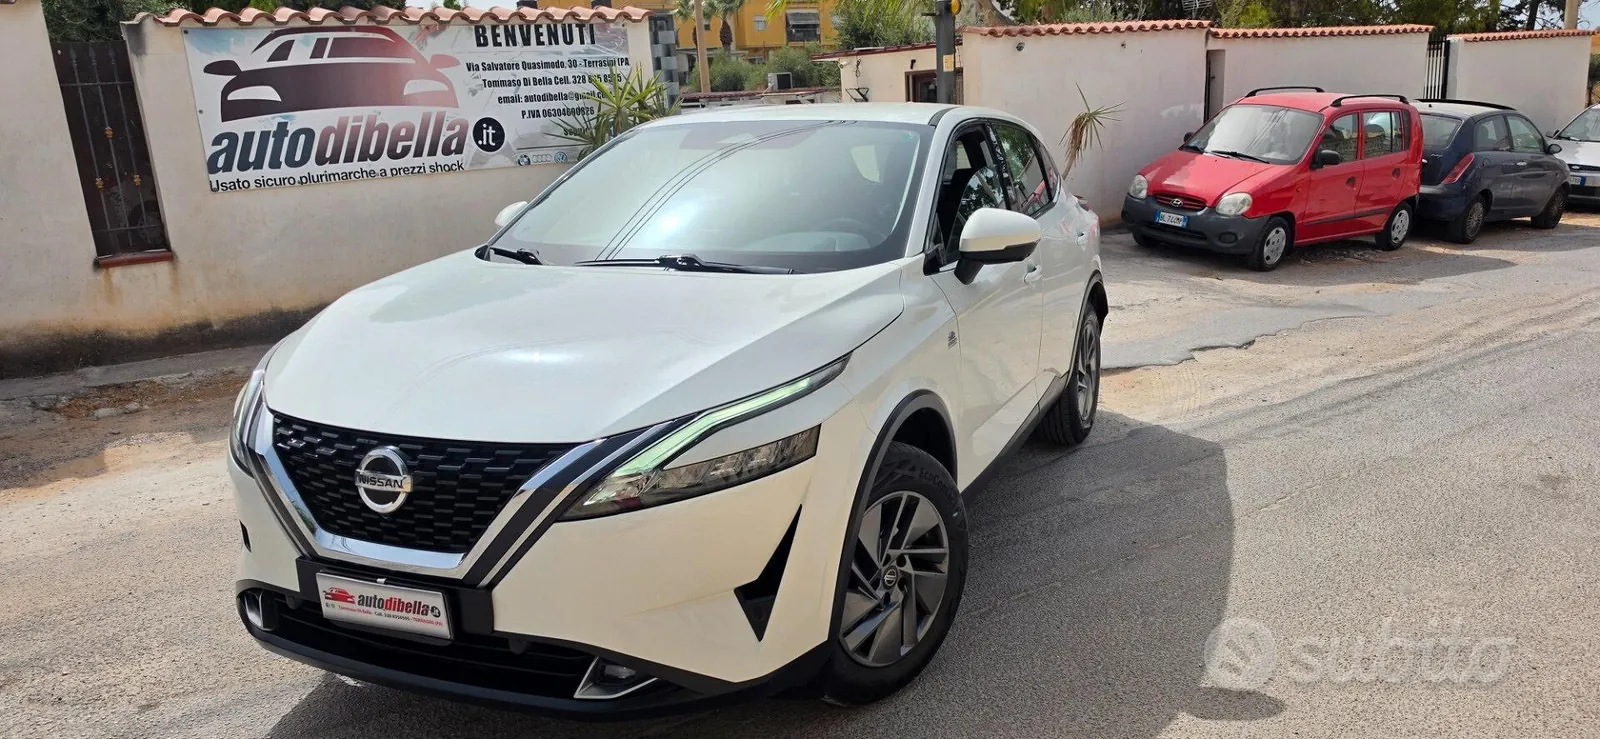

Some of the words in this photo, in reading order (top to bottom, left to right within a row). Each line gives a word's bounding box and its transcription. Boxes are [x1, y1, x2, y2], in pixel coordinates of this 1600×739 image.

[474, 23, 596, 47] BENVENUTI
[466, 62, 480, 72] Via
[481, 60, 521, 72] Salvatore
[567, 58, 578, 69] 30
[482, 78, 521, 89] Tommaso
[523, 77, 532, 87] Di
[533, 76, 552, 87] Bella
[554, 75, 571, 86] Cell.
[572, 74, 587, 85] 328
[498, 93, 523, 105] email:
[521, 109, 541, 119] P.IVA
[207, 111, 469, 175] autodibella
[478, 123, 496, 146] .it
[209, 178, 251, 193] Usato
[255, 175, 296, 189] sicuro
[299, 168, 377, 186] plurimarche
[379, 168, 388, 178] a
[390, 163, 427, 178] prezzi
[429, 160, 465, 174] shock
[359, 474, 404, 489] NISSAN
[357, 594, 429, 617] autodibella
